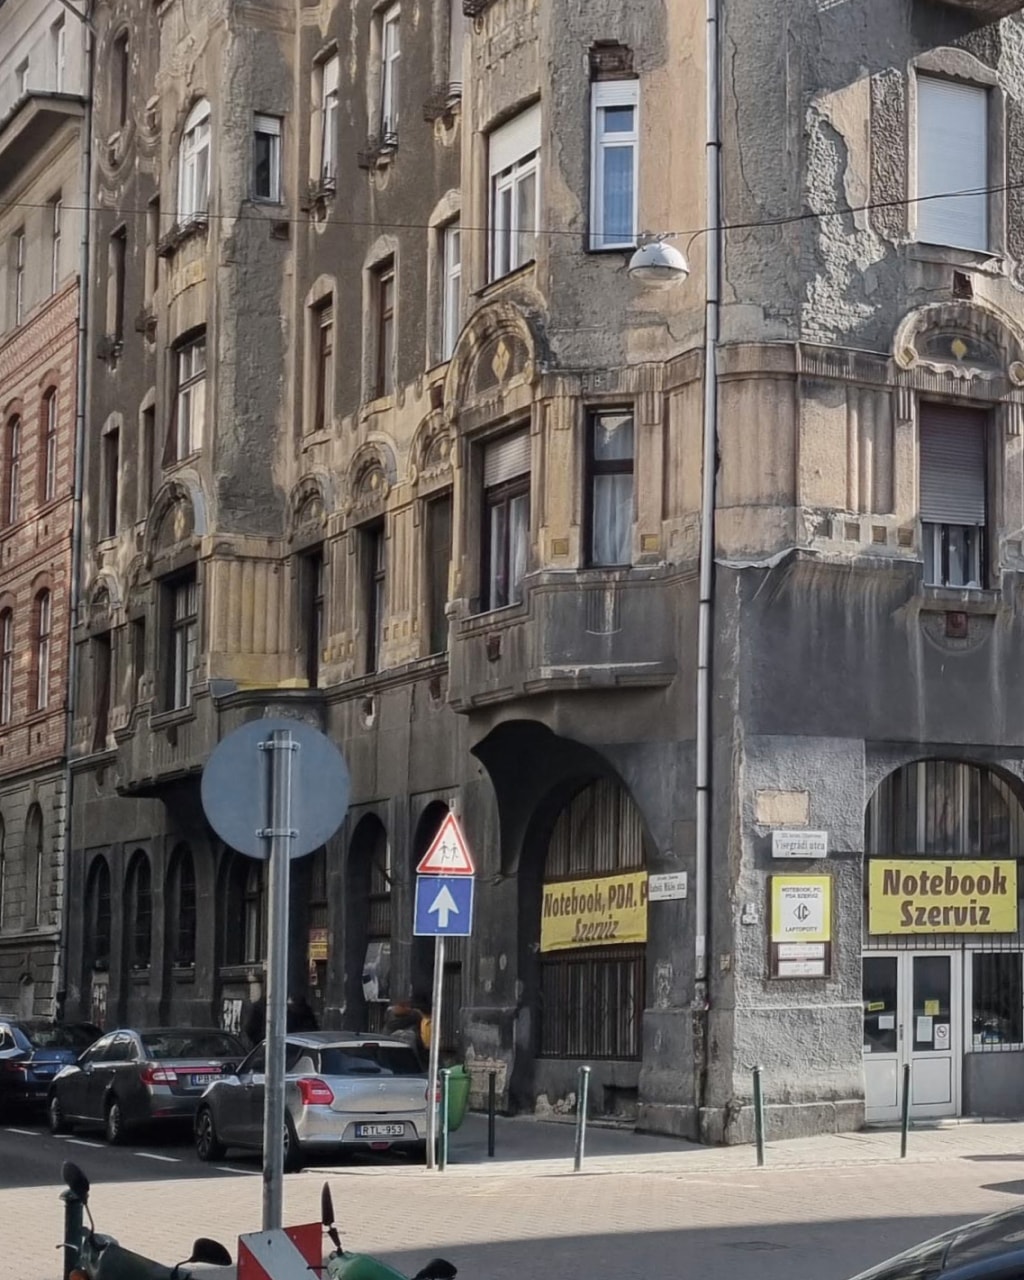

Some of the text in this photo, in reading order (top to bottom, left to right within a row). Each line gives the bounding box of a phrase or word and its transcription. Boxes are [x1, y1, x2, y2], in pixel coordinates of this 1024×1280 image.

[882, 866, 1007, 896] Notebook
[543, 883, 606, 918] Notebook,
[900, 899, 991, 927] Szerviz
[571, 914, 619, 942] Szerviz
[362, 1125, 402, 1135] RTL-953
